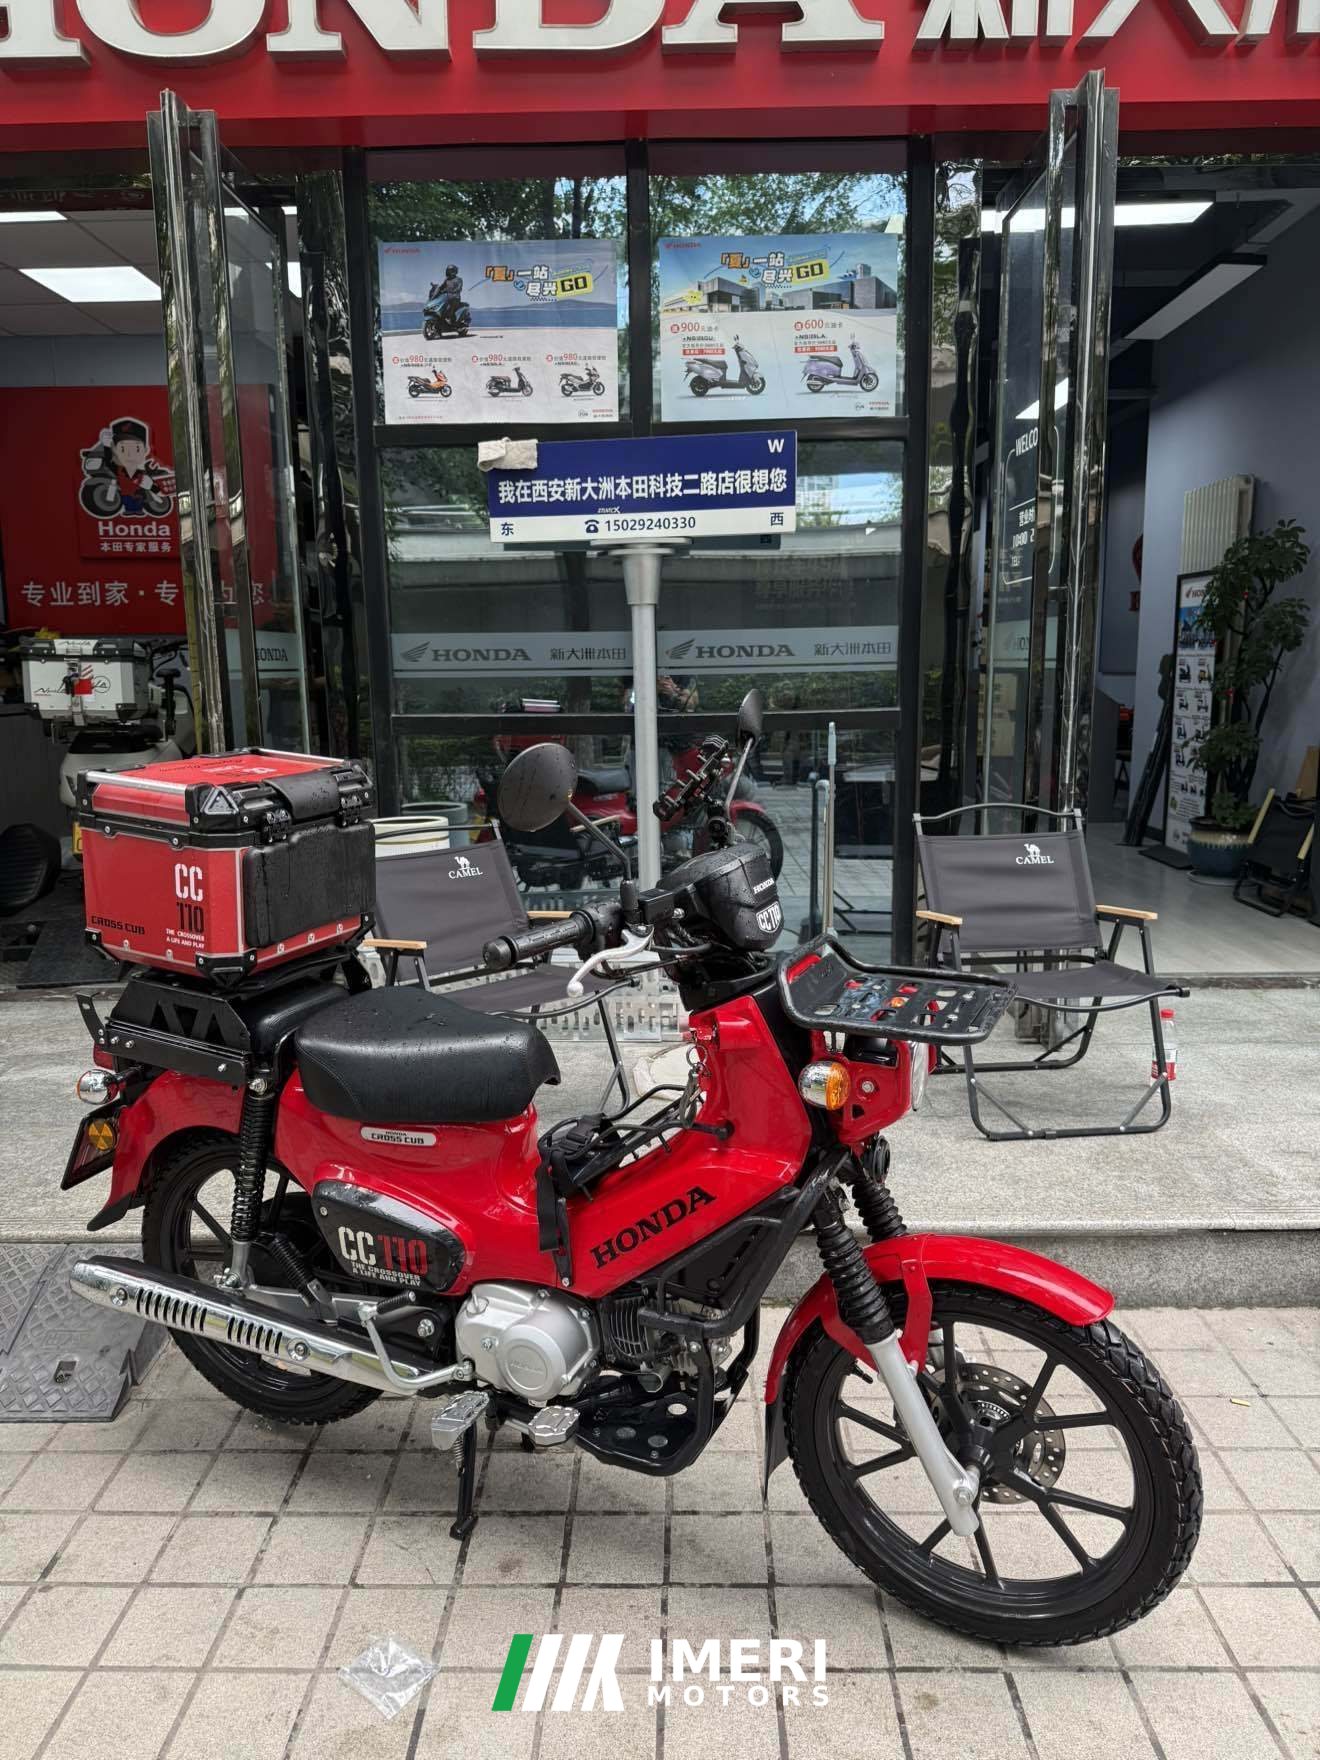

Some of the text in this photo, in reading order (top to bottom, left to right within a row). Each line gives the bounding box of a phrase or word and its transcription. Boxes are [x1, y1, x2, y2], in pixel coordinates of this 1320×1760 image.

[767, 439, 785, 453] W
[498, 467, 787, 504] 我在西安新大洲本田科技二路店很想您
[605, 516, 696, 531] 15029240330
[770, 511, 784, 526] 西
[98, 521, 171, 537] Honda
[501, 521, 514, 536] 东
[100, 541, 172, 553] 本田专家服务
[432, 647, 532, 662] HONDA
[696, 644, 796, 659] HONDA
[1016, 855, 1054, 865] CAMEL
[448, 867, 483, 879] CAMEL
[174, 863, 204, 902] CC
[753, 878, 774, 894] HONDA
[176, 901, 205, 933] 110
[91, 915, 145, 935] CROSS CUB
[166, 928, 205, 943] THE CROSSOVER
[371, 1132, 424, 1145] CROSS CUB
[590, 1185, 717, 1268] HONDA
[350, 1261, 420, 1281] THE CROSSOVER
[361, 1269, 377, 1279] LIFE
[379, 1273, 397, 1282] AND
[400, 1276, 421, 1287] PLAY
